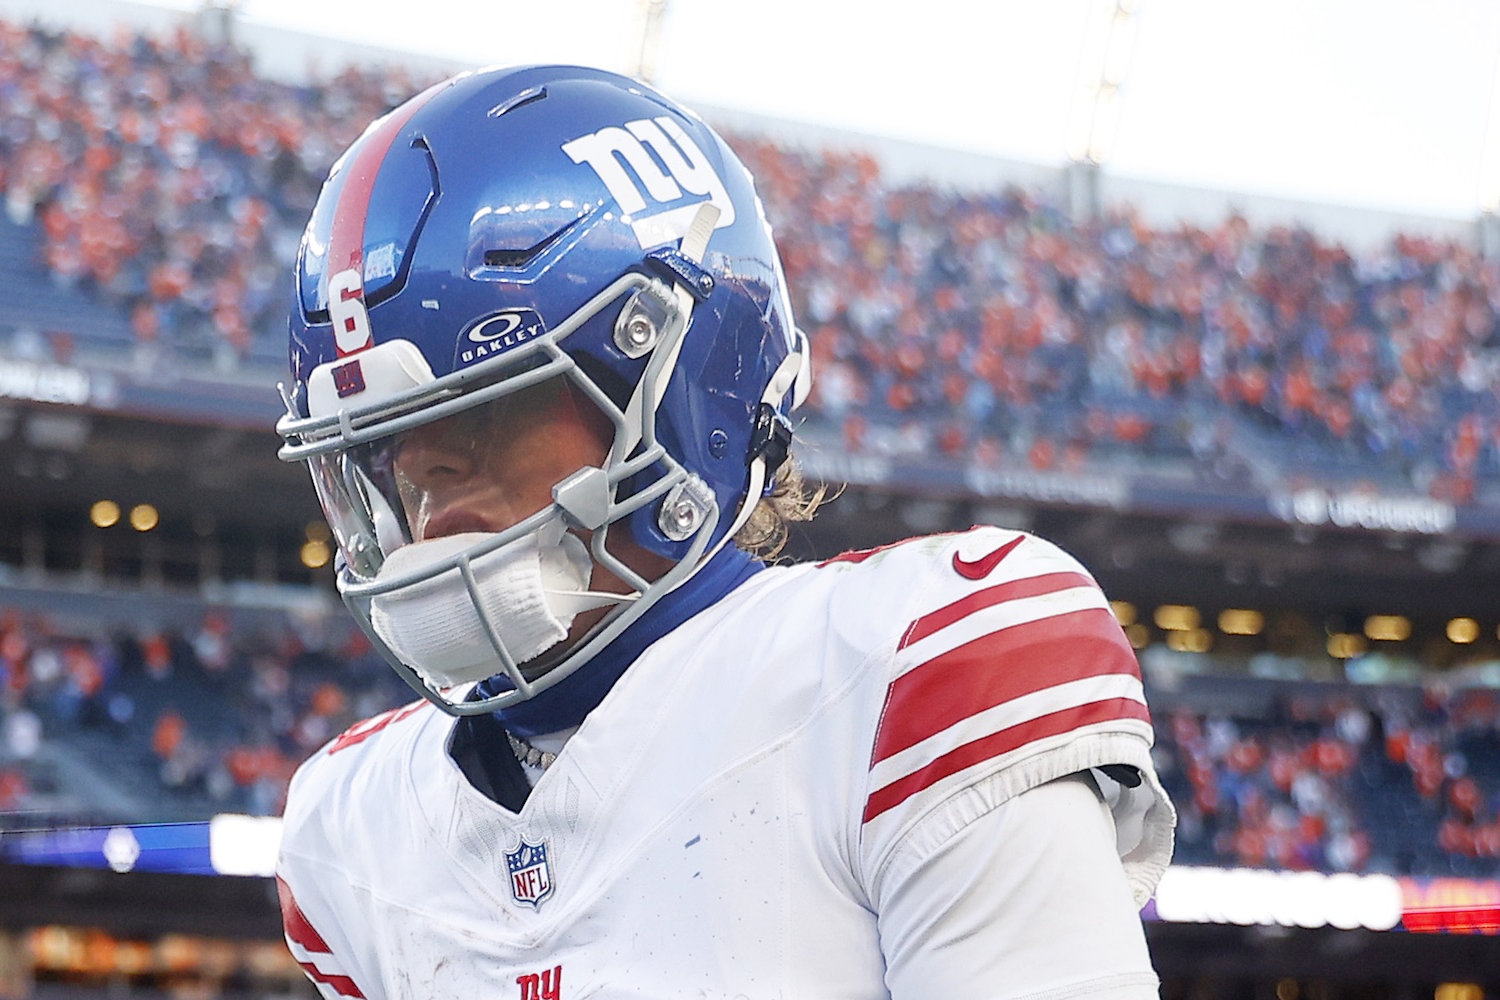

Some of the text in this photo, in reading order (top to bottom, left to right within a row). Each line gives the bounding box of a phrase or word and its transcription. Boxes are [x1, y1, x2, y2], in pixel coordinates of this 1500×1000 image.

[328, 268, 370, 353] 6
[461, 323, 541, 362] OAKLEY
[514, 867, 547, 898] NFL
